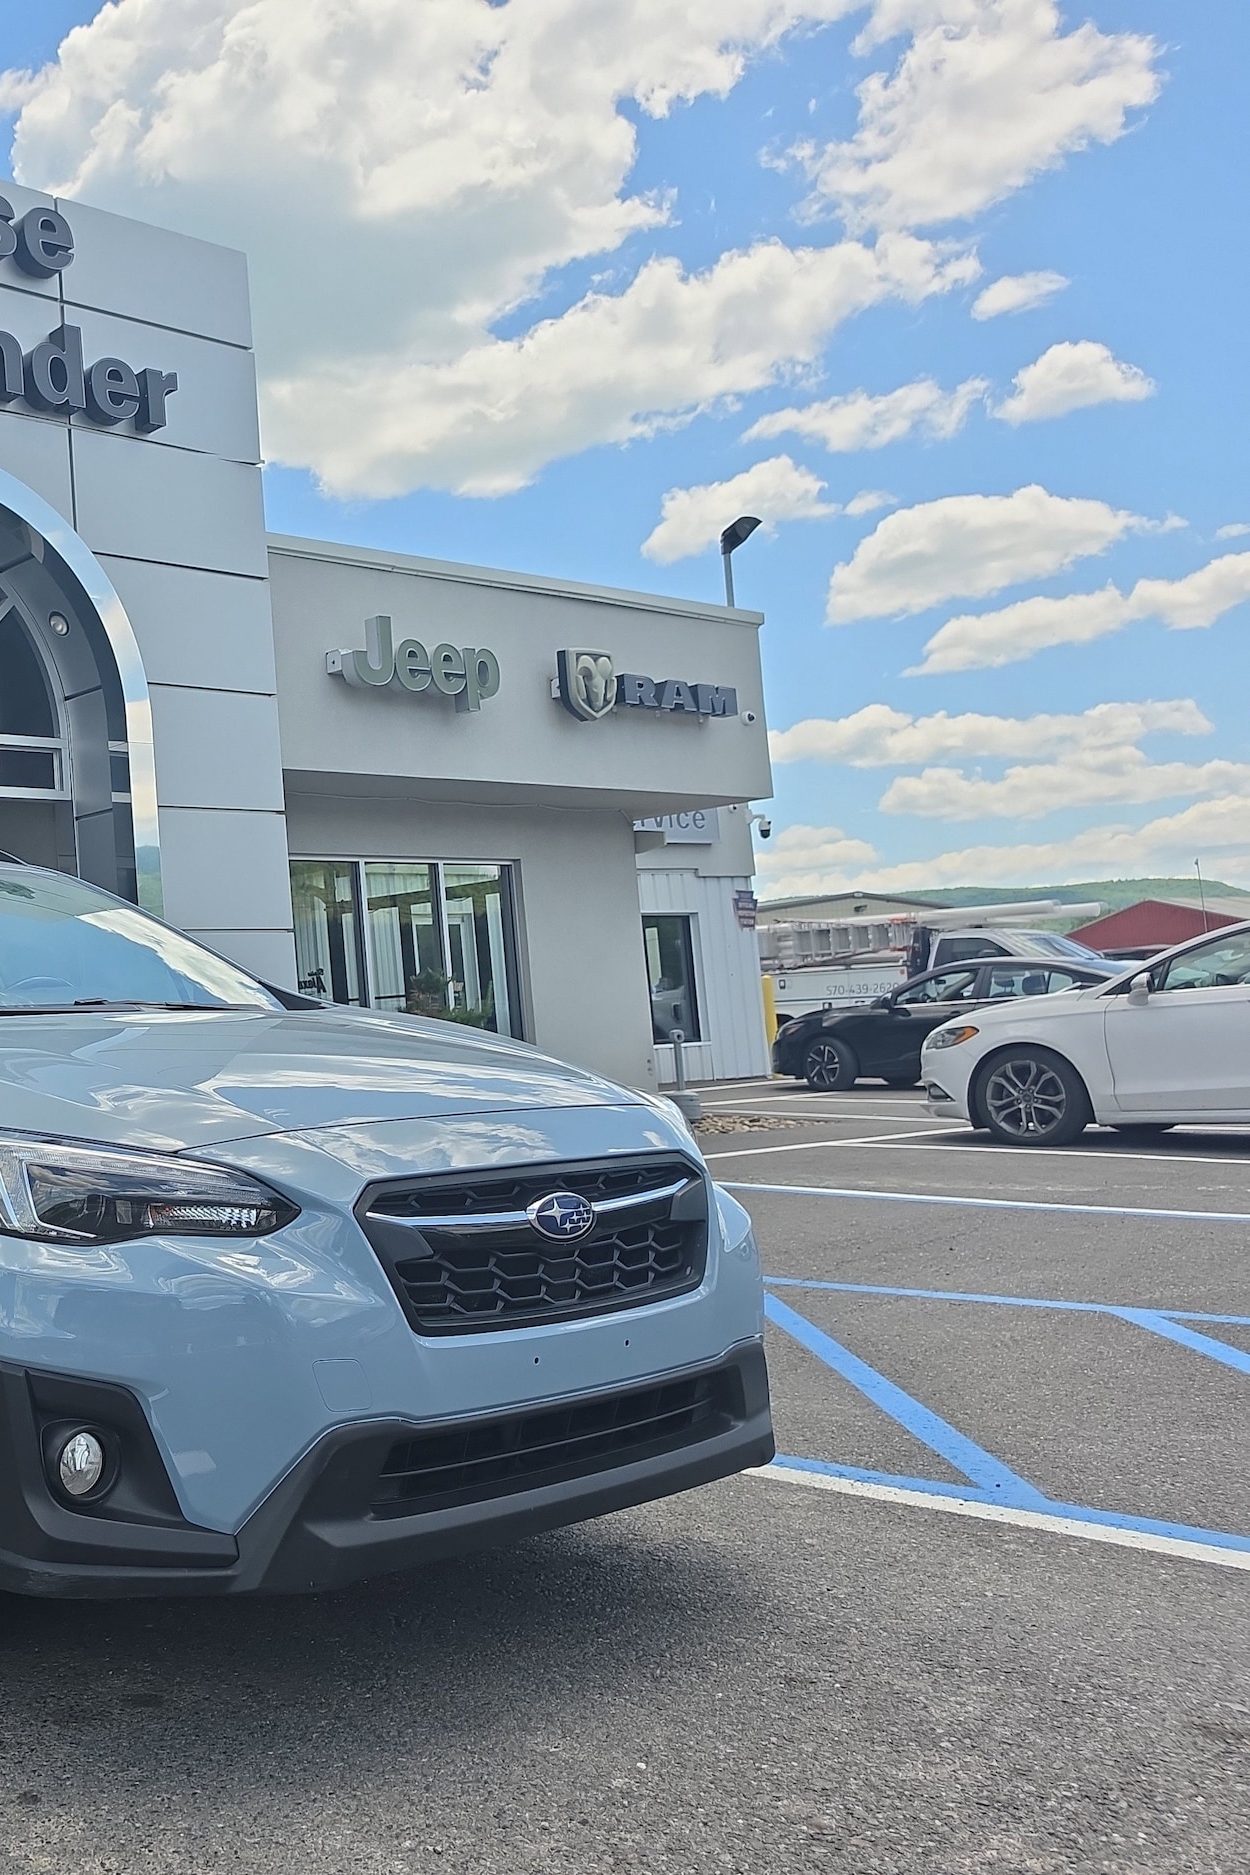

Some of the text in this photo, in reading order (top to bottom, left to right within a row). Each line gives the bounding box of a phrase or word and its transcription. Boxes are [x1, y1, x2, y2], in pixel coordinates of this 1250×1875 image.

[347, 615, 500, 713] Jeep
[620, 673, 738, 718] RAM
[632, 811, 706, 829] vice
